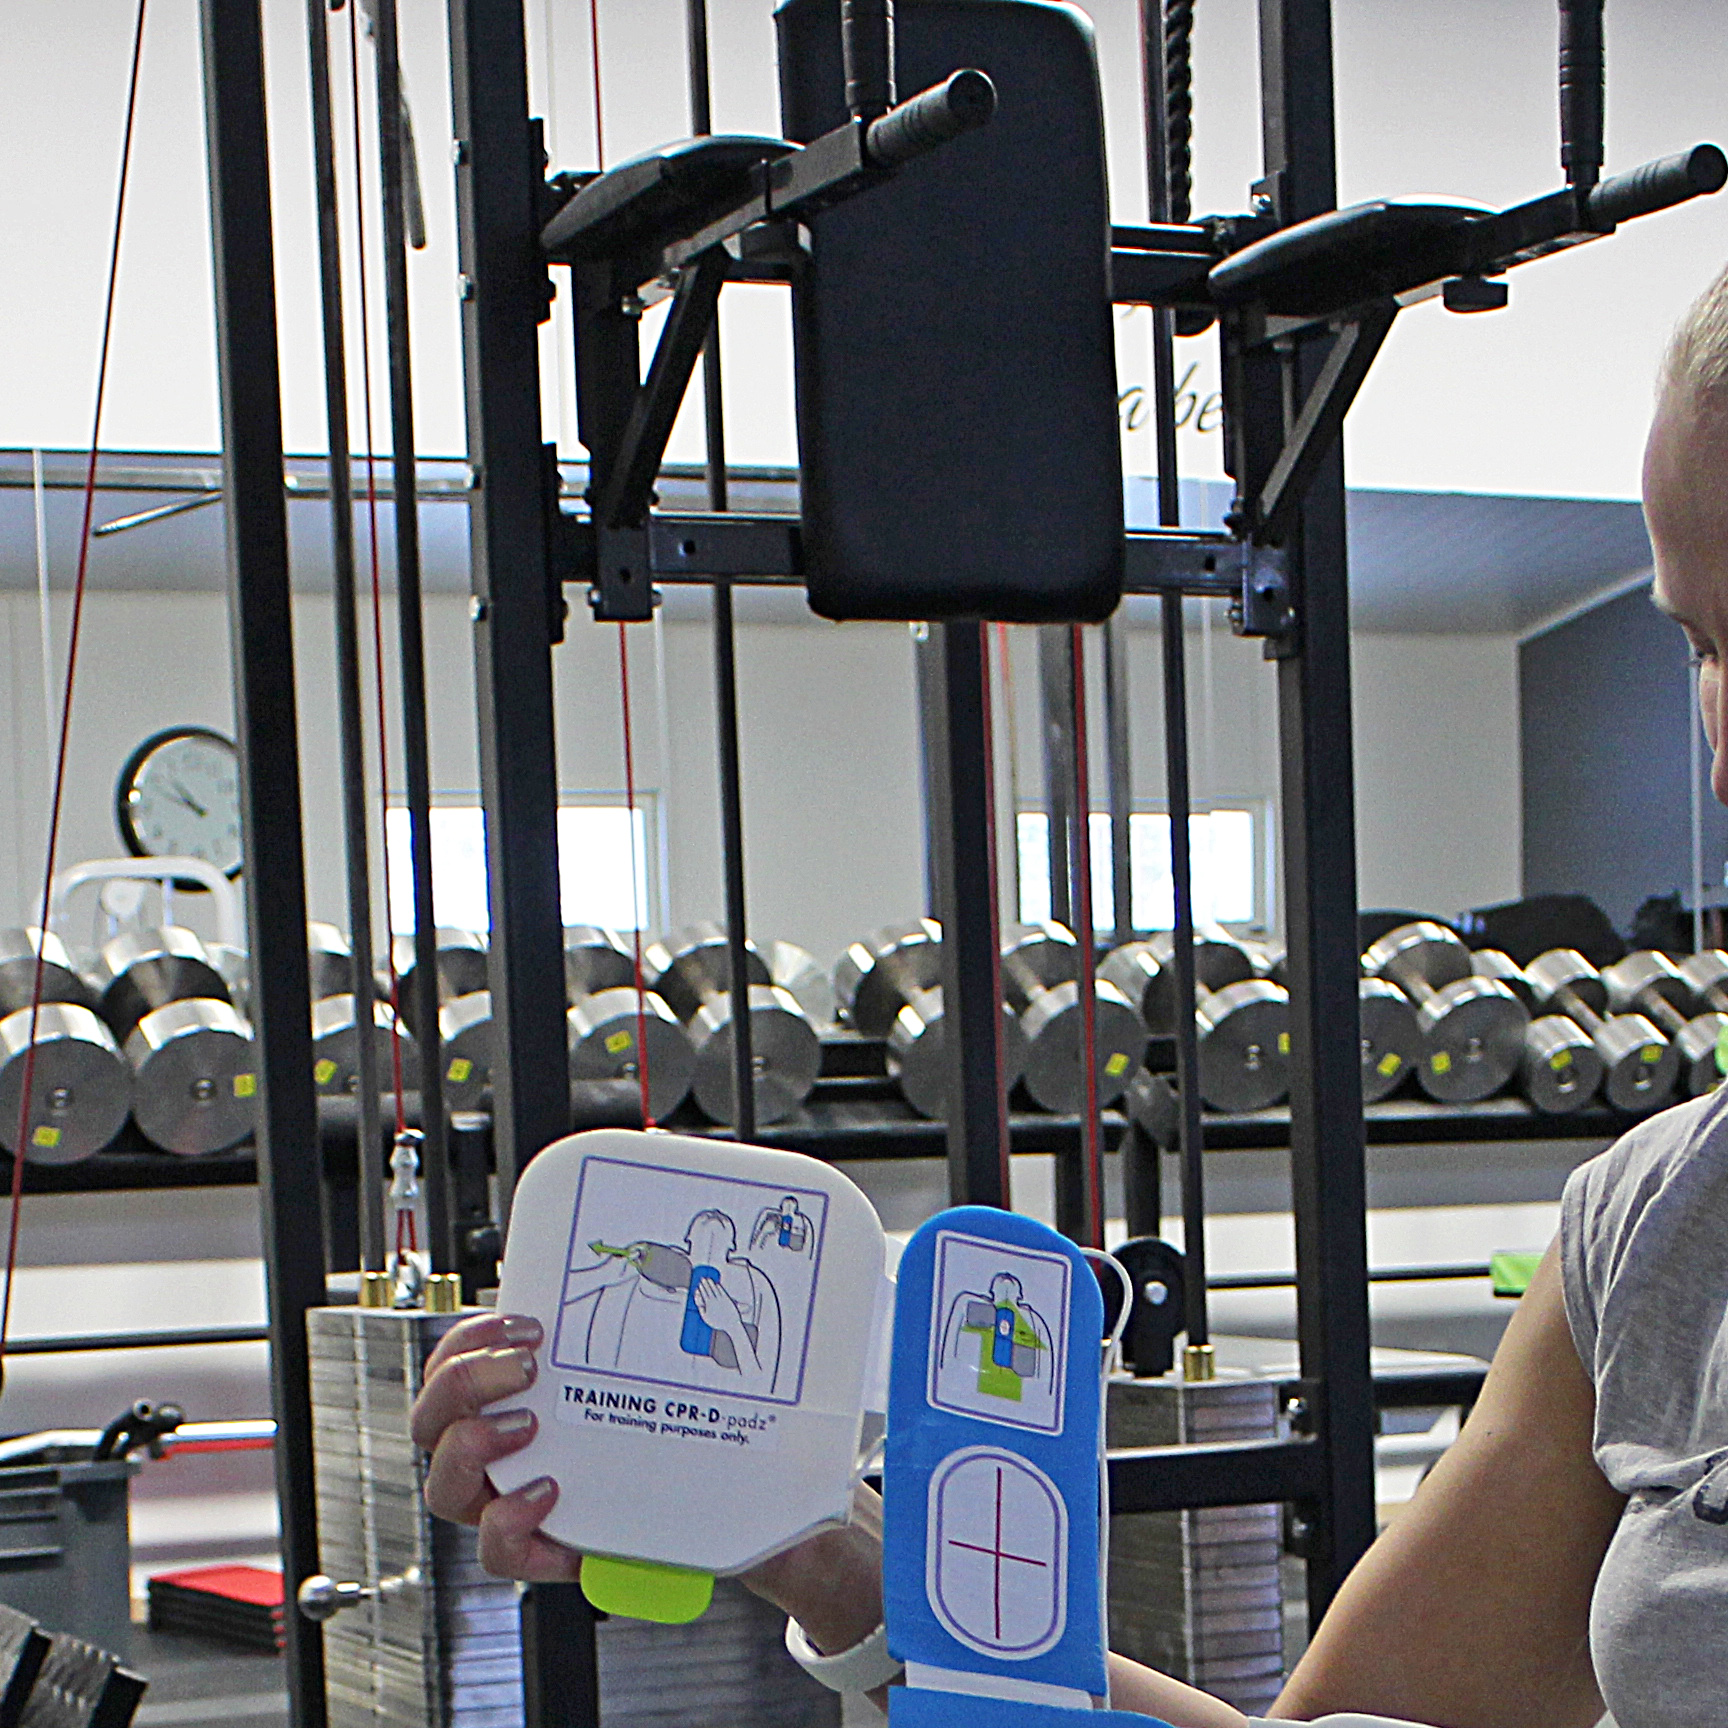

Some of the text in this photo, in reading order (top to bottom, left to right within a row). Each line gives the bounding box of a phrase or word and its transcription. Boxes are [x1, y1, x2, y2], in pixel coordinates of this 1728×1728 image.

[563, 1385, 657, 1414] TRAINING
[584, 1408, 750, 1446] For training purposes only.
